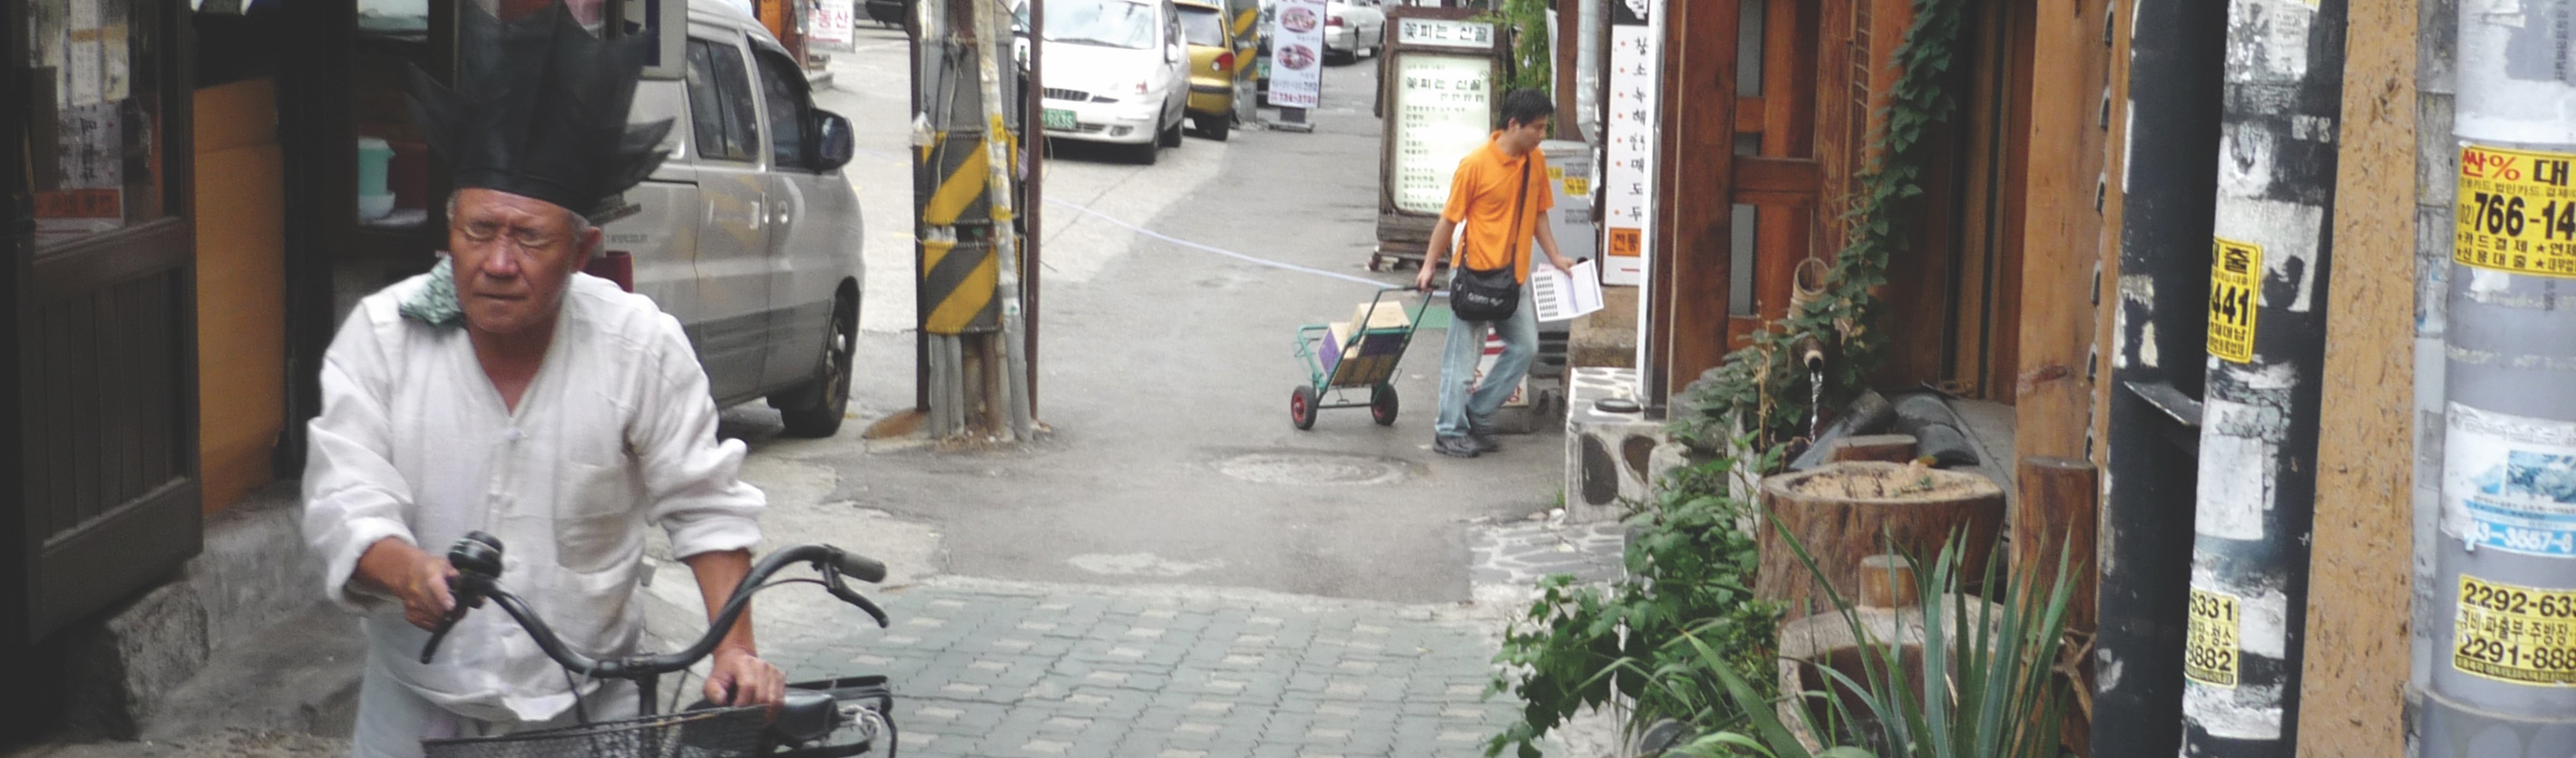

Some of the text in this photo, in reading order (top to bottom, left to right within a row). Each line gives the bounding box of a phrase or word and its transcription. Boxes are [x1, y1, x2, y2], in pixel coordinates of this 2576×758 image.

[1405, 22, 1449, 40] 꽃피는
[2463, 149, 2570, 187] 싼% 대
